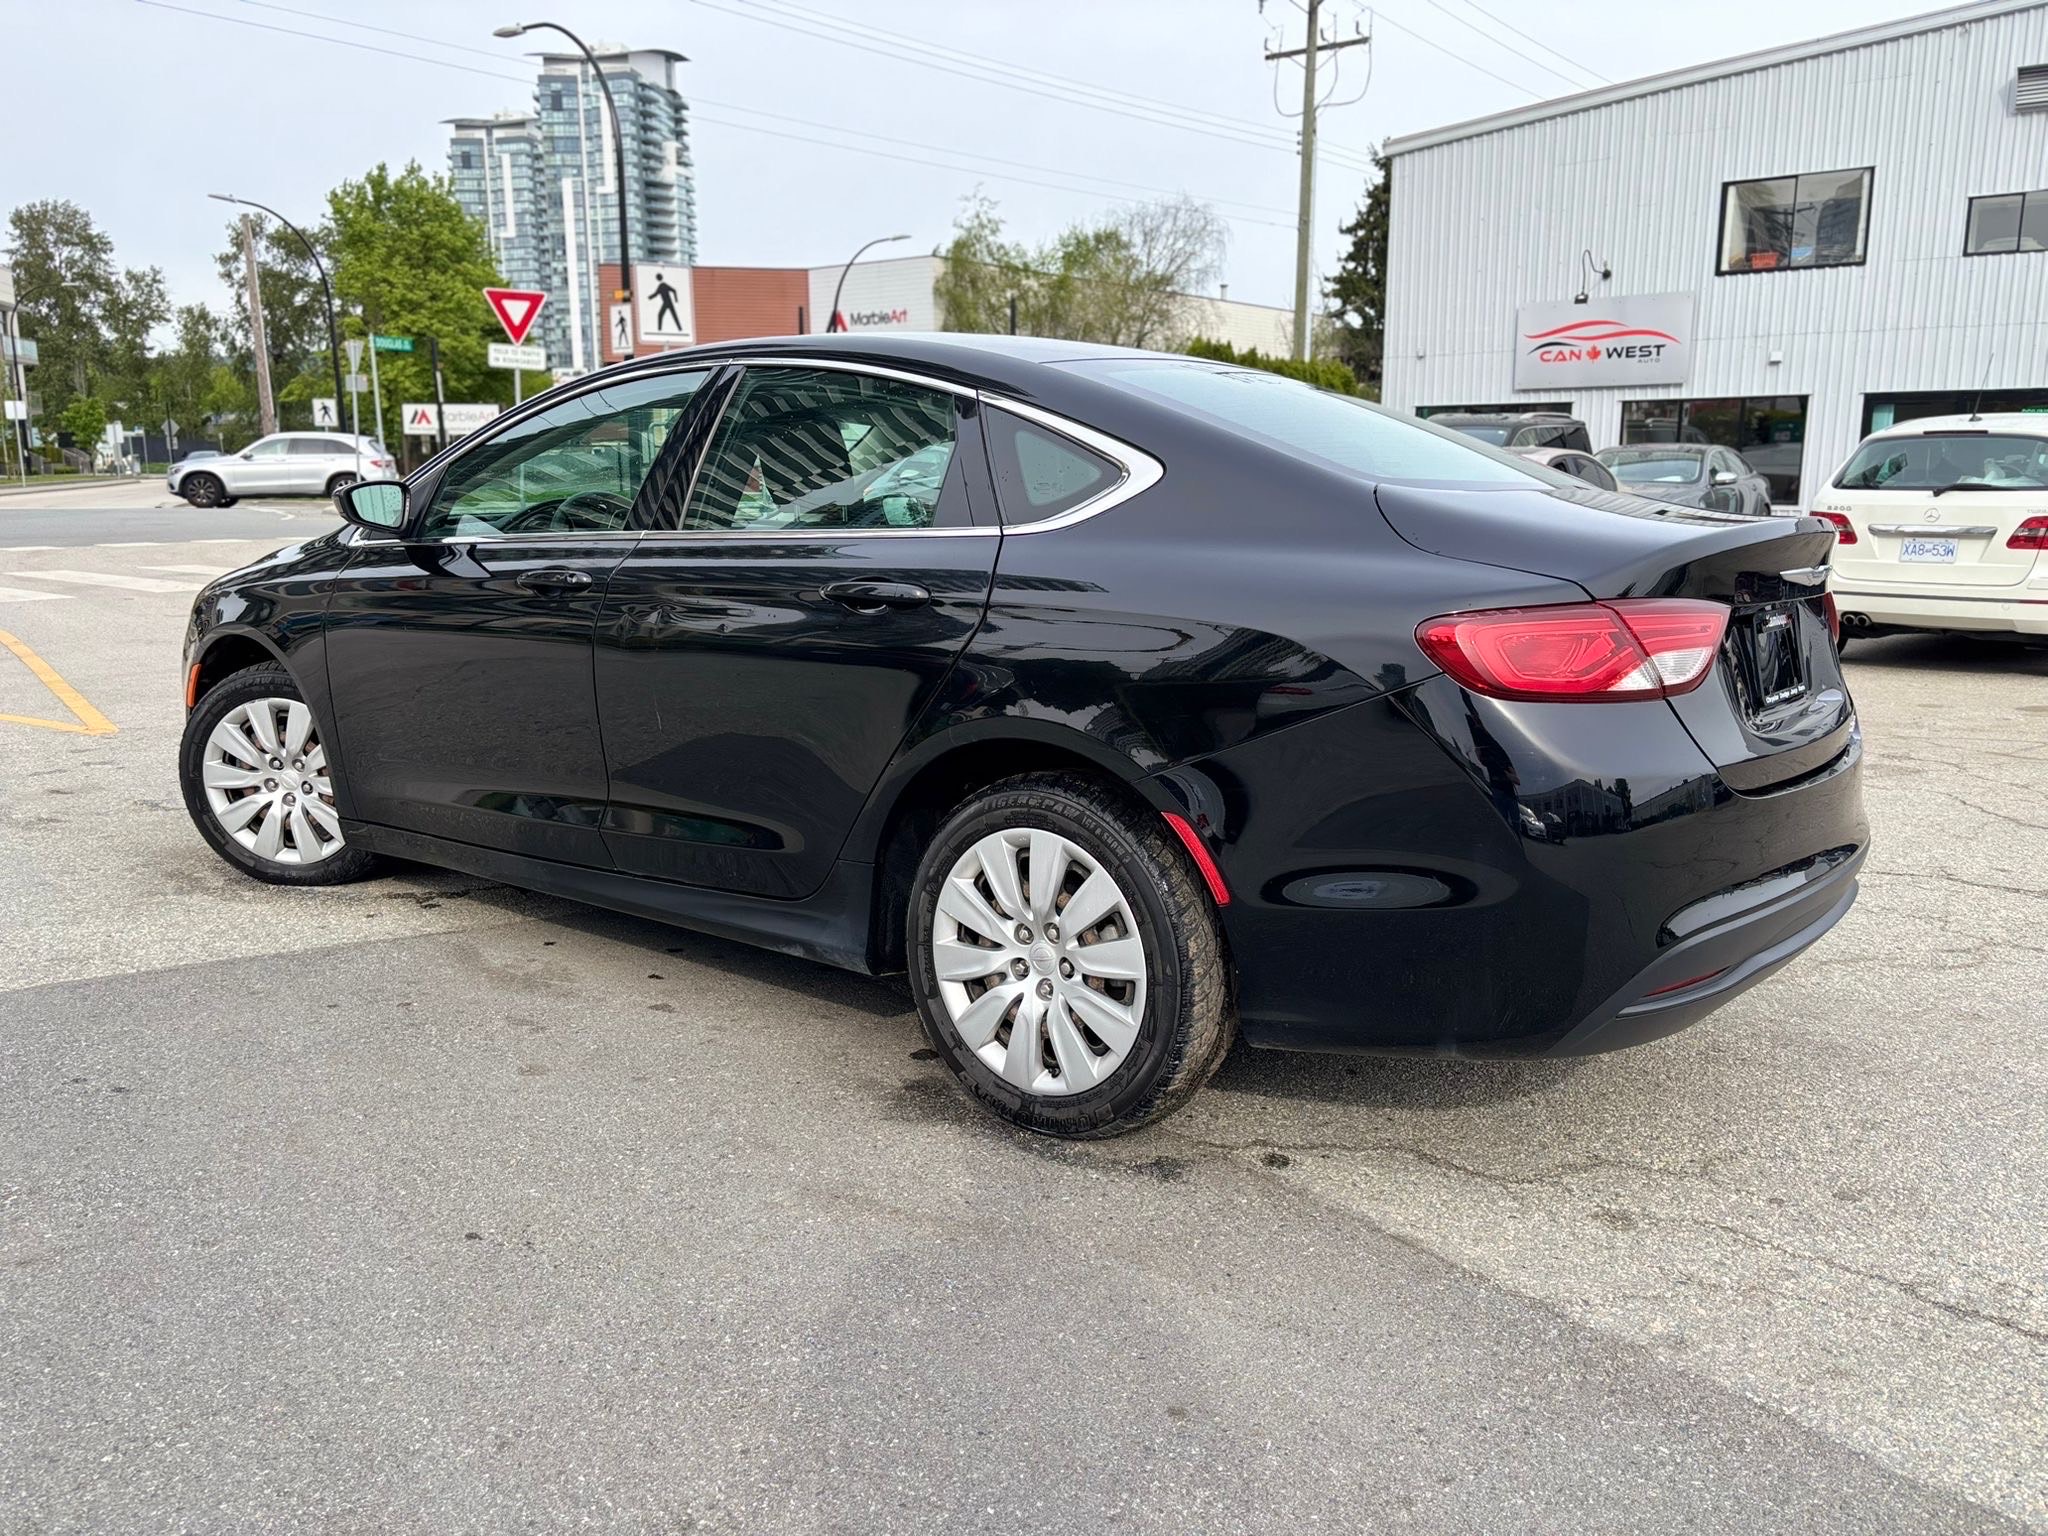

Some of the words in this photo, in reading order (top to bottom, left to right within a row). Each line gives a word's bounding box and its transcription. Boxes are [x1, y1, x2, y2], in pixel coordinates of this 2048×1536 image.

[850, 308, 908, 326] MarbleArt
[1539, 349, 1582, 363] CAN
[1605, 344, 1667, 360] WEST
[443, 407, 496, 421] arbleArt
